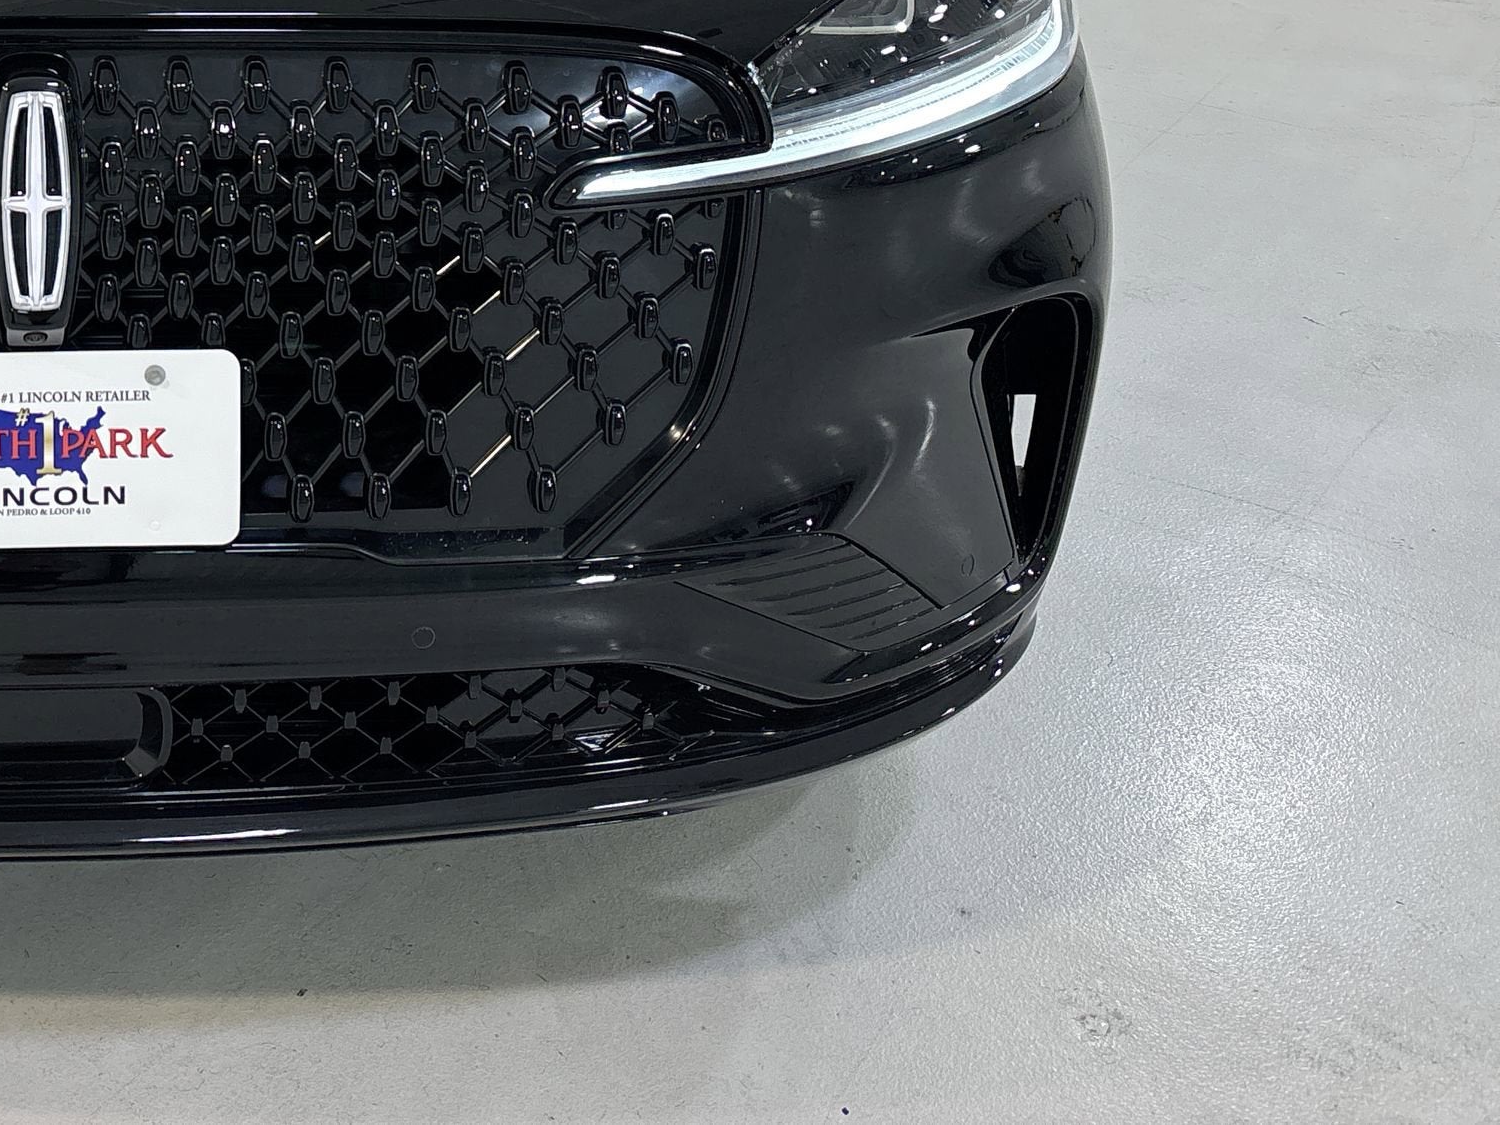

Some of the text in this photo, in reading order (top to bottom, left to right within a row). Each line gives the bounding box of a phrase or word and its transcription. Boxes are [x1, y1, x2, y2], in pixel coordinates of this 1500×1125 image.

[1, 392, 14, 403] #1
[19, 390, 82, 404] LINCOLN
[85, 390, 151, 402] RETAILER
[61, 427, 174, 459] PARK
[49, 508, 75, 516] LOOP
